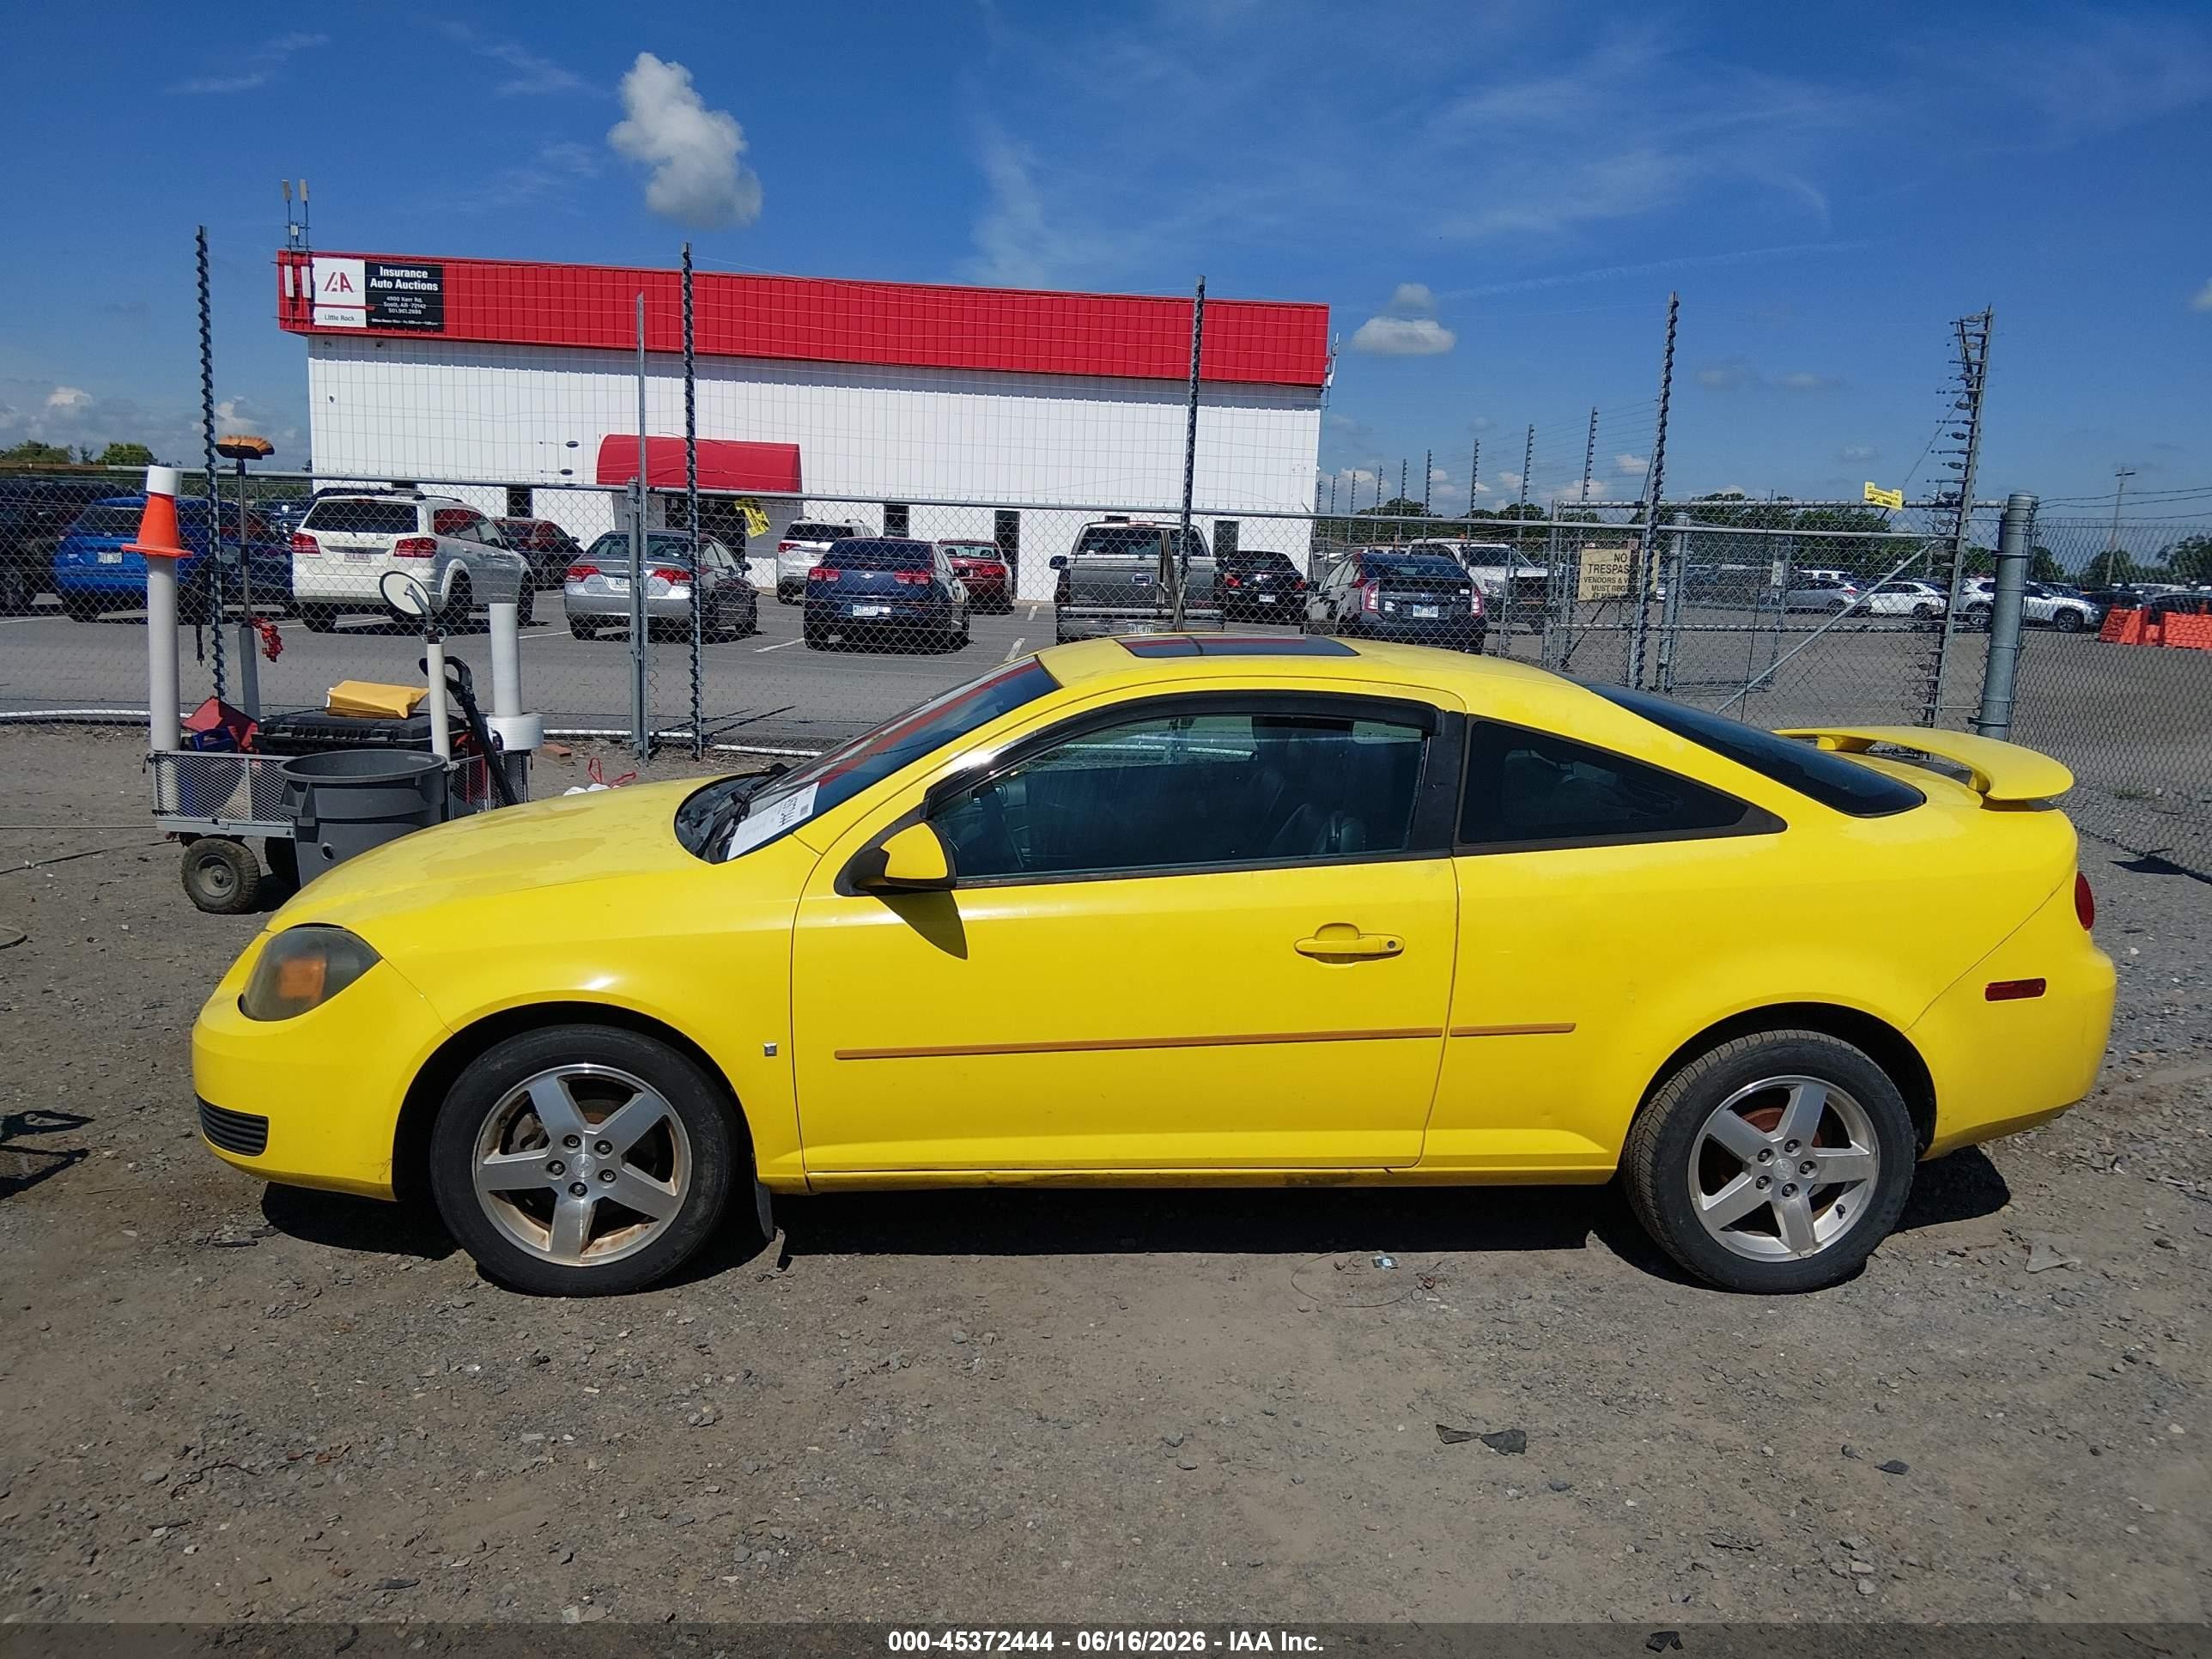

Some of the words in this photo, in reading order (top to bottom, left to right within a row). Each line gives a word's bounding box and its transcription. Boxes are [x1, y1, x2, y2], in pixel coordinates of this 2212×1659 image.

[380, 266, 428, 278] Insurance
[370, 278, 392, 289] Auto
[395, 279, 439, 291] Auctions
[1613, 553, 1627, 562] NO
[1588, 564, 1642, 574] TRESPAS
